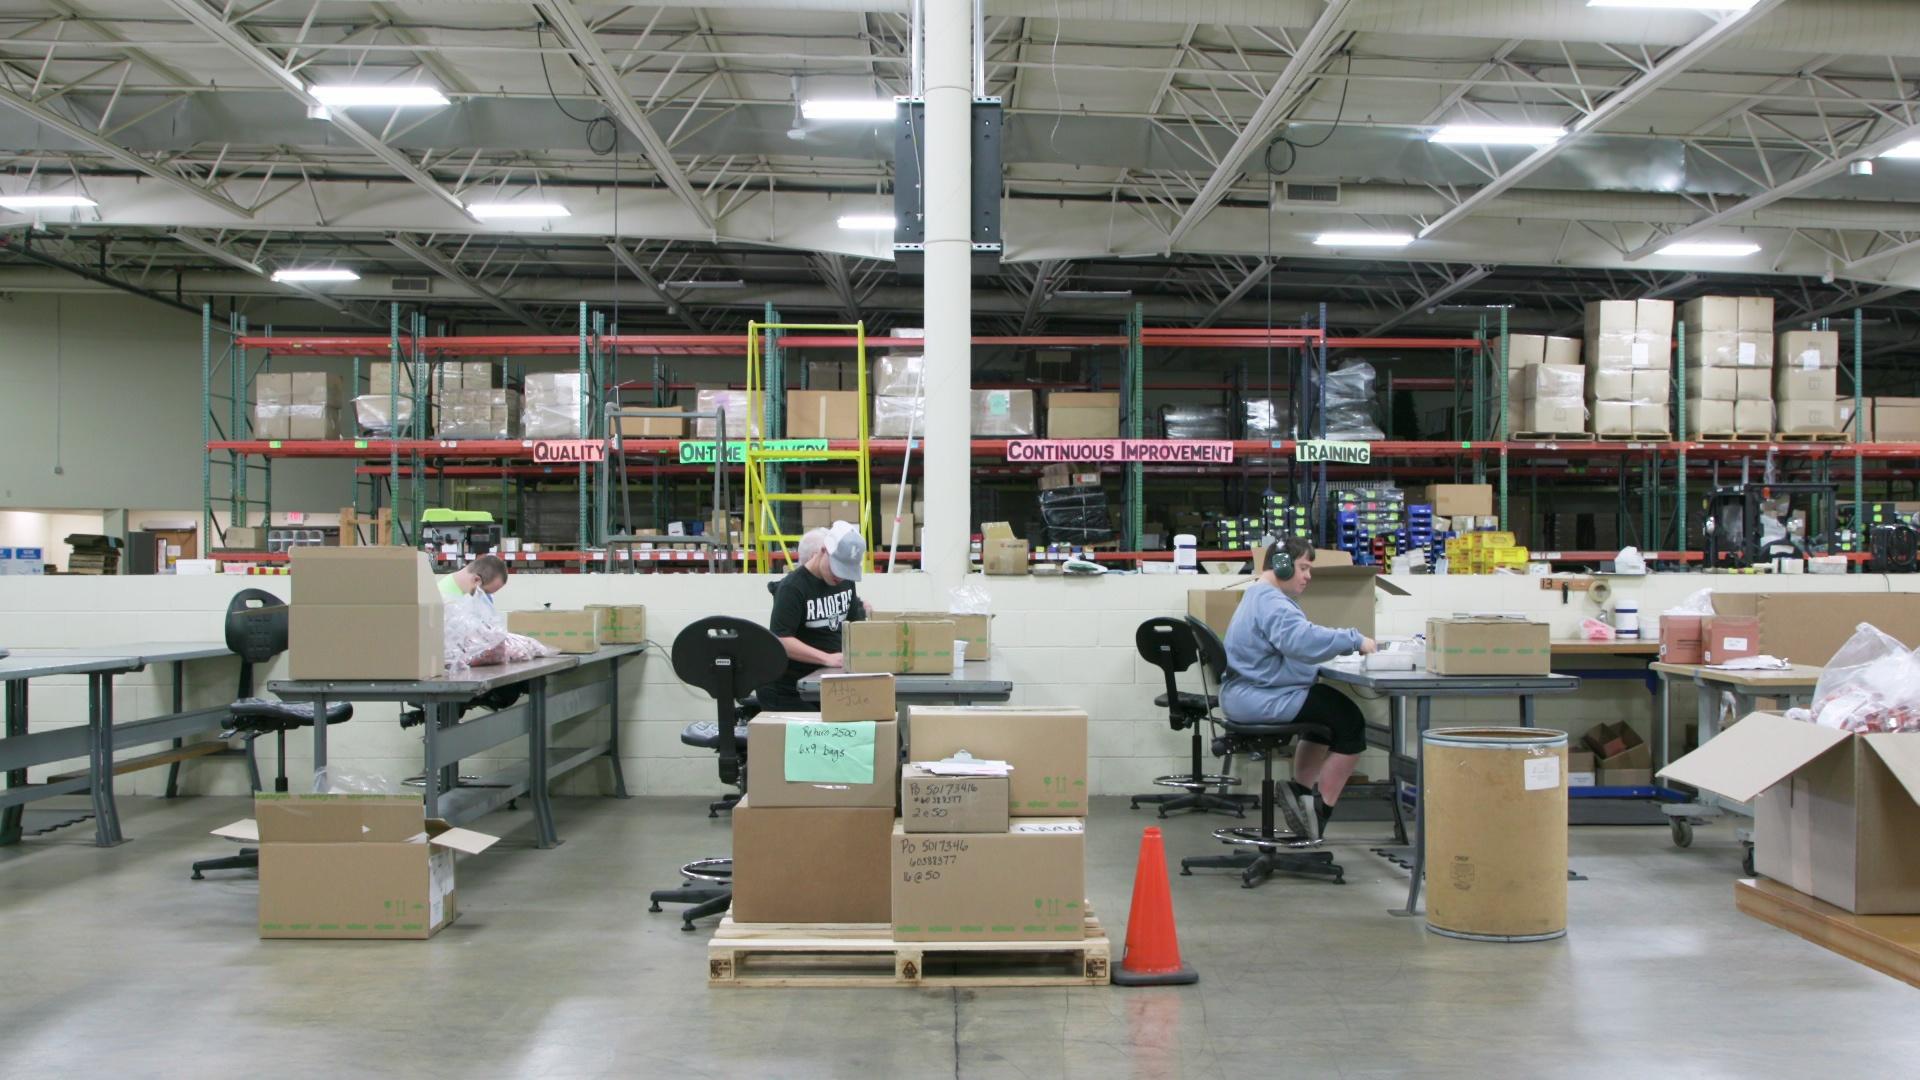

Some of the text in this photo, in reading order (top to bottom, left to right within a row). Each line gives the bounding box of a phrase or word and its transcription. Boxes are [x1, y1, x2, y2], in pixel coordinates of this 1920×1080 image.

[534, 441, 604, 461] QUALITY
[680, 443, 742, 462] ON-TME
[1008, 441, 1232, 461] CONTINUOUS IMPROVEMENT
[1297, 442, 1369, 462] TRAINING
